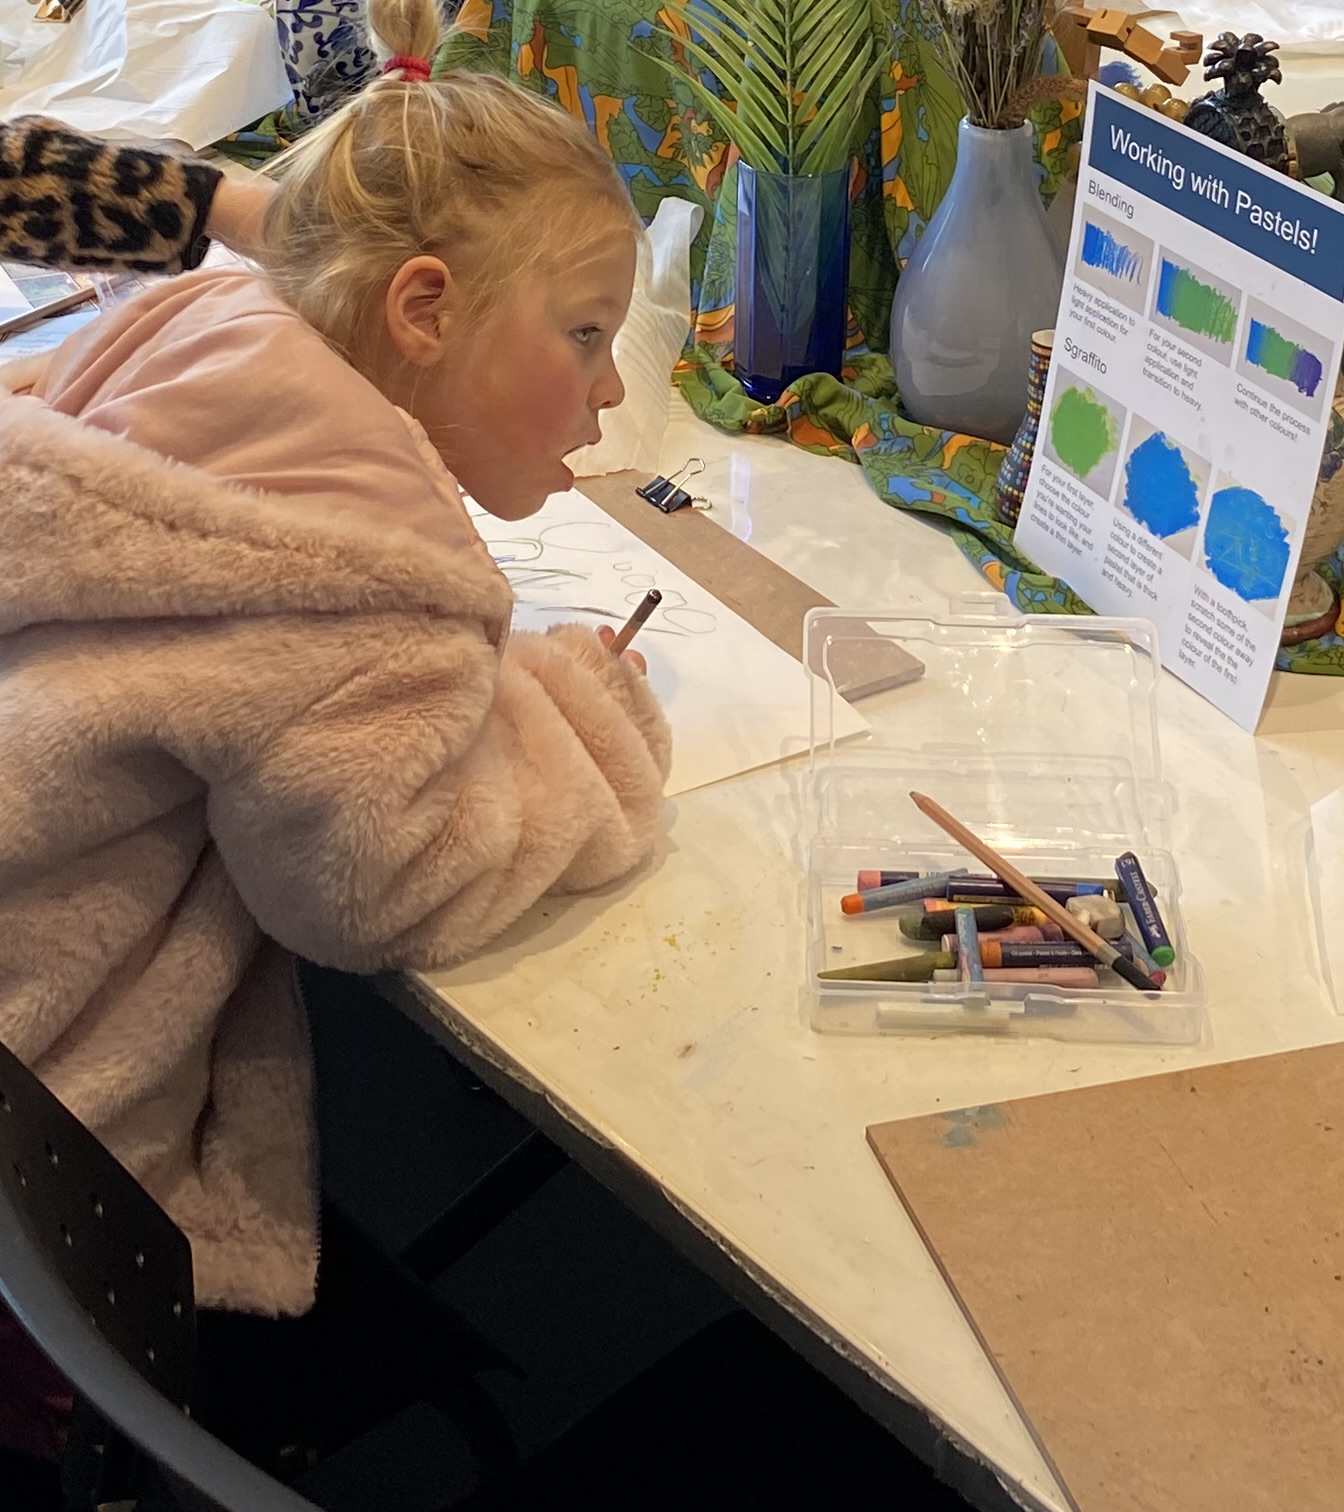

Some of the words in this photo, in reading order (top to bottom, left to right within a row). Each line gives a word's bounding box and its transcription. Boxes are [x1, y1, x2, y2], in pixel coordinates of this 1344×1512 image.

[1088, 180, 1134, 219] Blending
[1110, 124, 1186, 191] Working
[1190, 171, 1230, 208] with
[1235, 189, 1319, 254] Pastels!
[1070, 309, 1083, 322] your
[1084, 316, 1096, 329] first
[1096, 326, 1117, 344] colour.
[1071, 295, 1084, 310] light
[1085, 305, 1118, 329] application
[1120, 324, 1129, 336] for
[1073, 283, 1093, 301] Heavy
[1094, 296, 1127, 322] application
[1129, 316, 1135, 327] to
[1064, 337, 1107, 374] Sgraffito
[1147, 343, 1168, 362] colour,
[1170, 357, 1182, 369] use
[1184, 363, 1198, 379] light
[1149, 329, 1161, 341] For
[1162, 339, 1177, 351] your
[1178, 348, 1202, 367] second
[1143, 367, 1172, 391] transition
[1173, 386, 1180, 396] to
[1181, 391, 1202, 411] heavy.
[1144, 356, 1179, 381] application
[1181, 378, 1194, 391] and
[1234, 397, 1248, 411] with
[1250, 407, 1269, 423] other
[1269, 420, 1297, 441] colours!
[1237, 383, 1268, 408] Continue
[1269, 403, 1280, 416] the
[1282, 412, 1311, 435] process
[1039, 478, 1060, 498] choose
[1061, 492, 1070, 505] the
[1072, 503, 1090, 519] colour
[1041, 464, 1052, 477] For
[1052, 475, 1066, 487] your
[1066, 482, 1078, 496] first
[1030, 514, 1049, 532] create
[1055, 530, 1066, 545] thin
[1034, 501, 1047, 516] lines
[1048, 511, 1055, 521] to
[1055, 515, 1067, 530] look
[1081, 537, 1094, 551] and
[1036, 490, 1054, 507] you're
[1055, 503, 1078, 527] wanting
[1078, 521, 1092, 535] your
[1110, 531, 1129, 549] colour
[1130, 545, 1136, 554] to
[1137, 552, 1156, 570] create
[1113, 517, 1131, 538] Using
[1137, 537, 1162, 560] different
[1101, 569, 1114, 581] and
[1104, 556, 1123, 574] pastel
[1123, 569, 1136, 584] that
[1136, 581, 1142, 589] is
[1143, 585, 1158, 601] thick
[1107, 544, 1129, 564] second
[1130, 559, 1145, 576] layer
[1146, 573, 1154, 582] of
[1191, 600, 1215, 622] scratch
[1216, 618, 1235, 637] some
[1236, 632, 1244, 643] of
[1245, 637, 1256, 652] the
[1194, 584, 1209, 602] With
[1210, 599, 1215, 607] a
[1216, 602, 1248, 632] toothpick,
[1181, 638, 1203, 657] colour
[1203, 654, 1211, 664] of
[1211, 658, 1222, 673] the
[1223, 668, 1238, 685] first
[1185, 624, 1191, 635] to
[1192, 631, 1214, 651] reveal
[1215, 646, 1225, 660] the
[1227, 655, 1238, 669] the
[1188, 613, 1212, 635] second
[1213, 631, 1235, 649] colour
[1235, 648, 1254, 667] away
